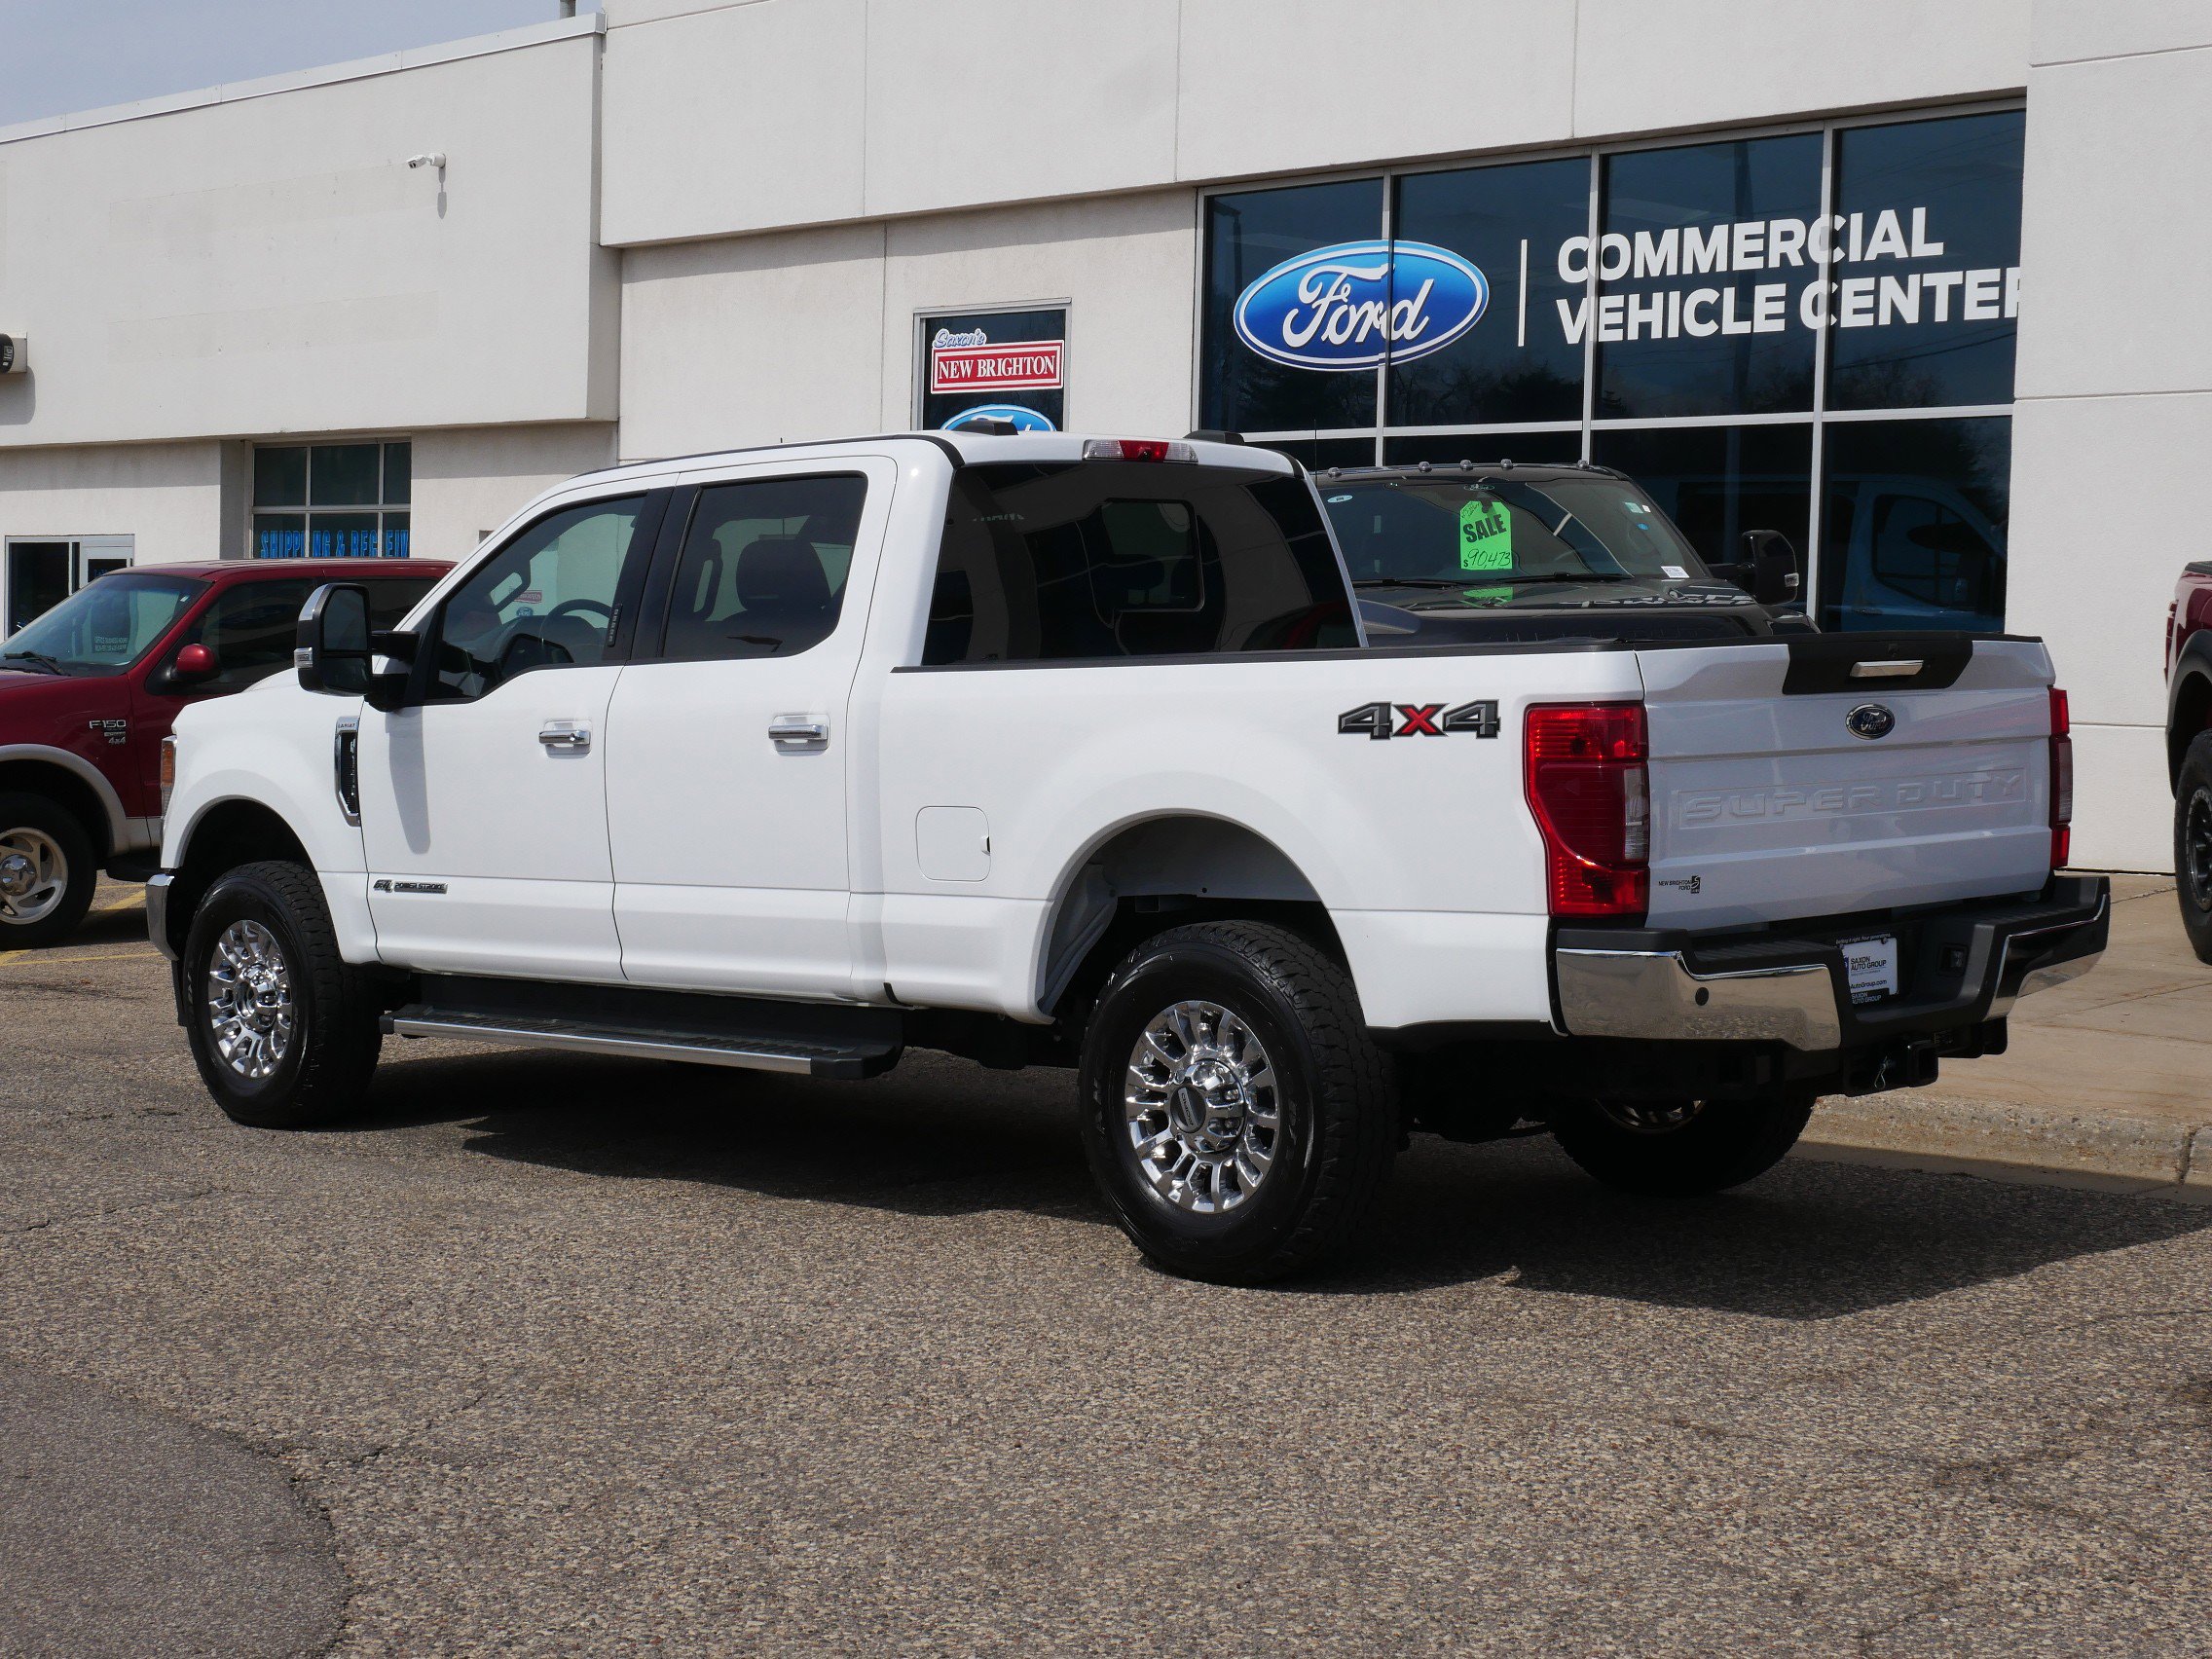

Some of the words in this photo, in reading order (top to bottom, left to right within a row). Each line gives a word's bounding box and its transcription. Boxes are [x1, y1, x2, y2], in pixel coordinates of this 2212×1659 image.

[1558, 207, 1944, 283] COMMERCIAL
[1282, 263, 1434, 348] Ford
[1556, 283, 1787, 345] VEHICLE
[933, 328, 986, 349] Saxon's
[938, 359, 975, 380] NEW
[977, 355, 1055, 378] BRIGHTON
[1462, 513, 1507, 544] SALE
[260, 530, 331, 558] SHIPPING
[1684, 786, 1879, 821] SUPER
[1899, 774, 2021, 804] DUTY
[1850, 956, 1870, 965] SAXON
[1851, 962, 1866, 972] AUTO
[1867, 960, 1887, 969] GROUP
